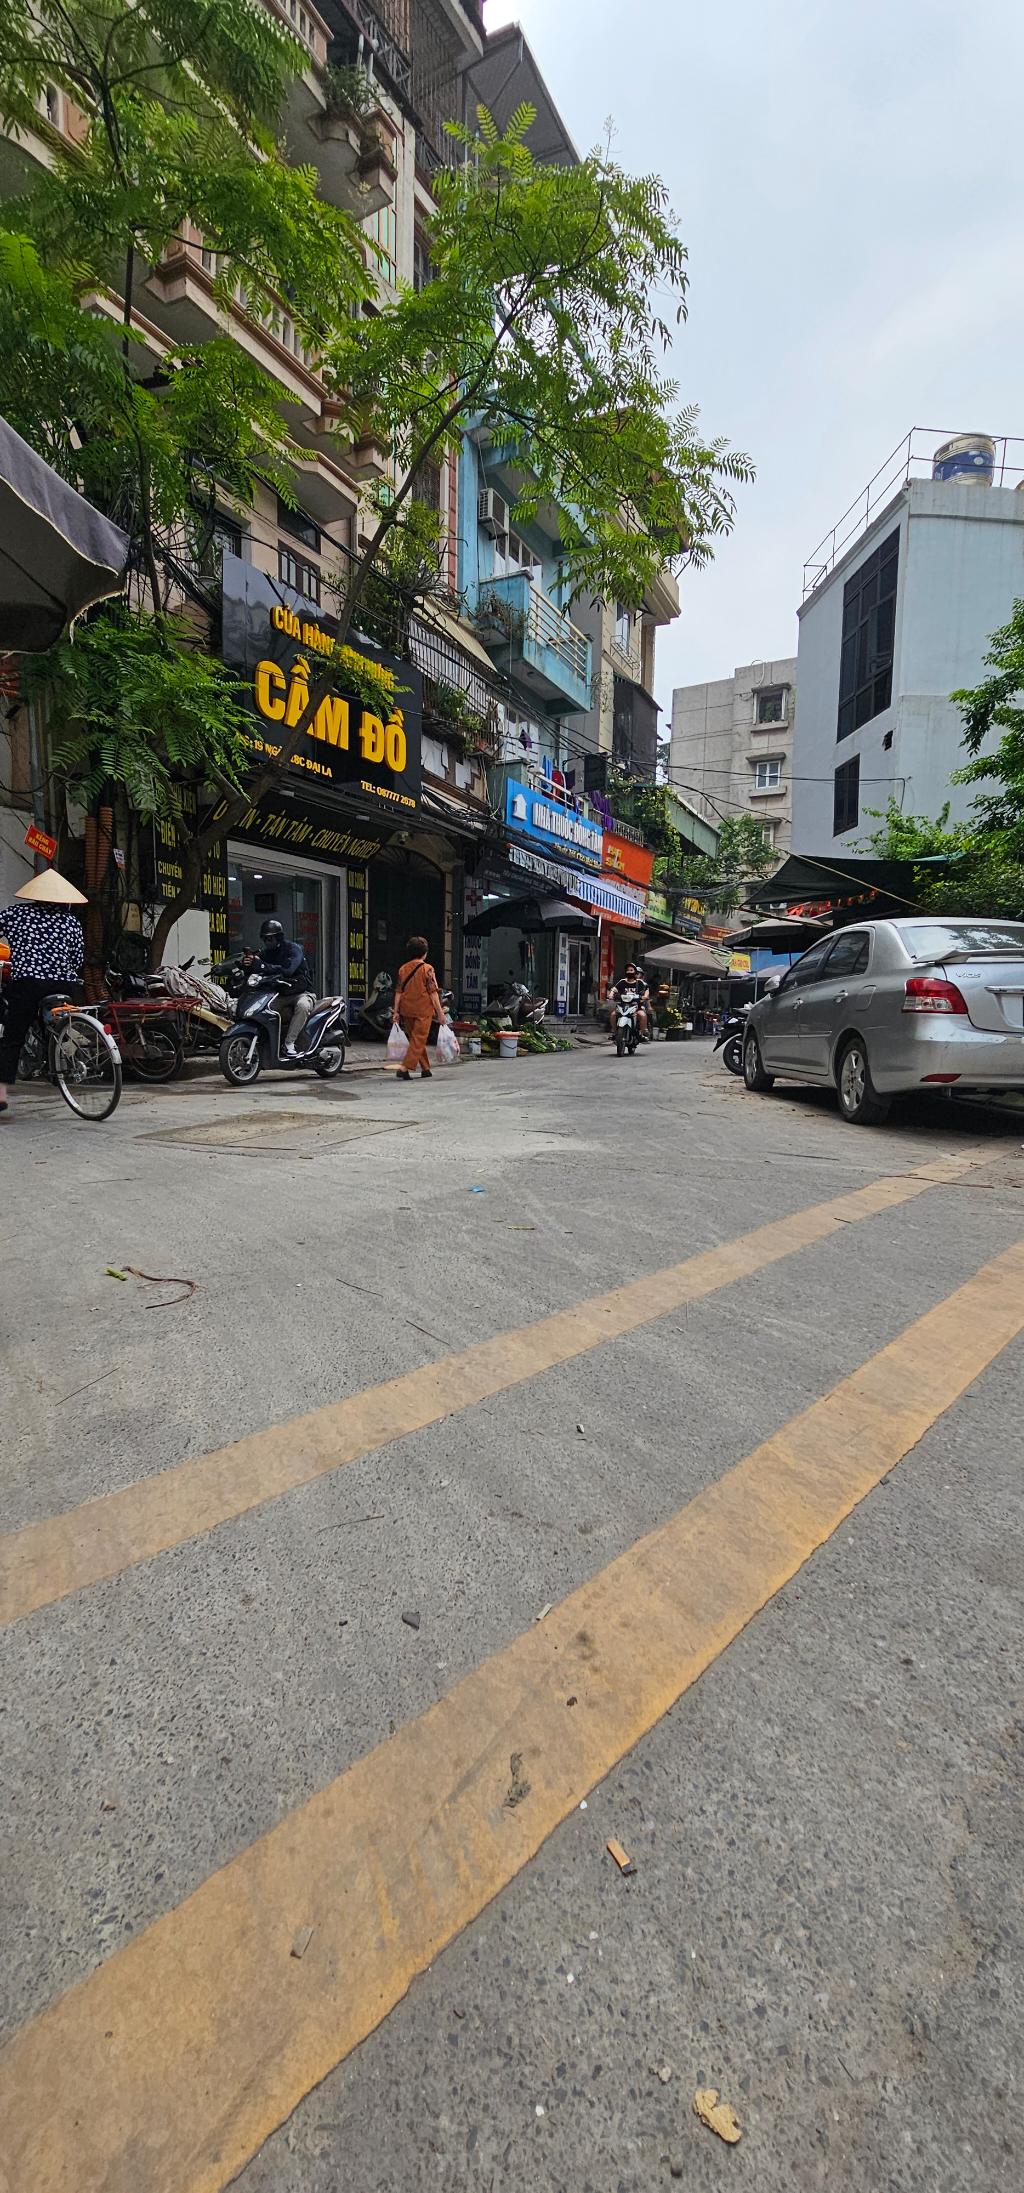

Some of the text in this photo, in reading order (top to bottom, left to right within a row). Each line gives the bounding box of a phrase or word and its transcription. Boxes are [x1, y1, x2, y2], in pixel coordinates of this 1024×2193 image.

[255, 654, 349, 750] CẦM
[359, 706, 407, 773] ĐỒ
[305, 759, 321, 774] ĐẠI
[321, 765, 333, 778] LA
[360, 780, 376, 794] TEL:
[260, 809, 289, 840] TẬN
[283, 816, 313, 843] TÂM
